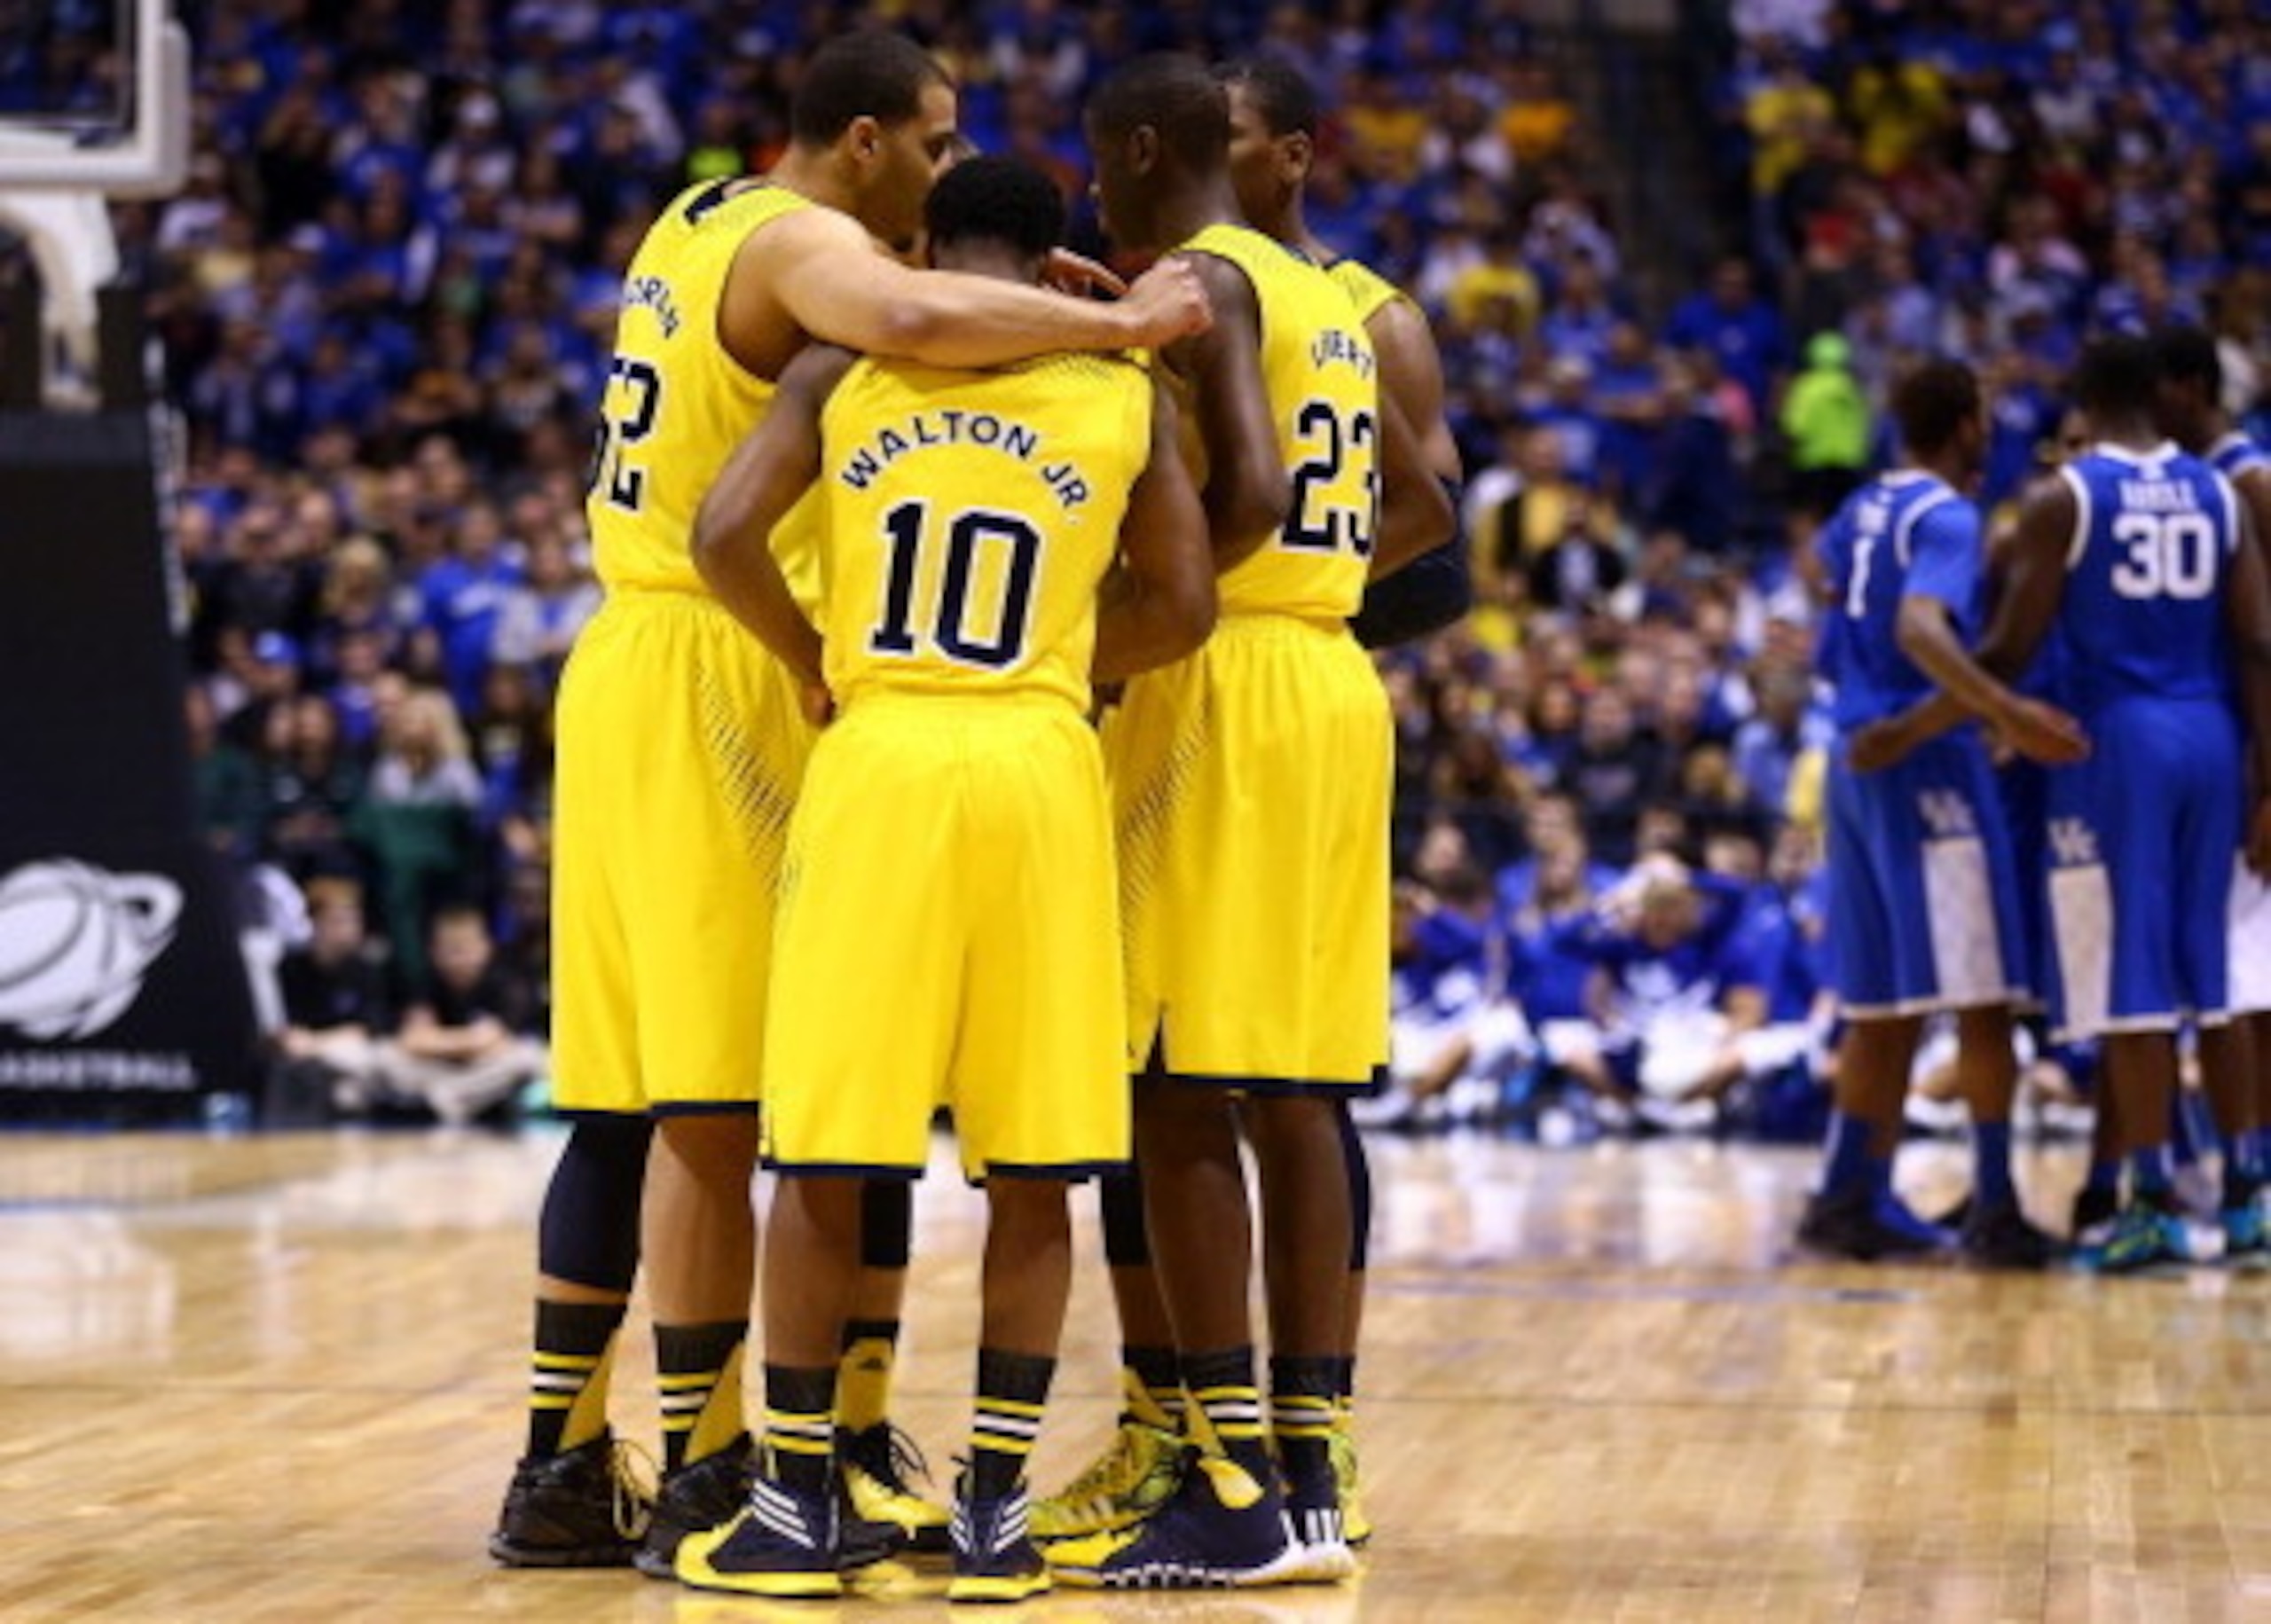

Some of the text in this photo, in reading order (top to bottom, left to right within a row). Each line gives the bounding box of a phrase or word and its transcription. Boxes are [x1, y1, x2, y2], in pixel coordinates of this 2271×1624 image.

[842, 412, 1037, 489] WALTON
[868, 500, 1043, 671] 10
[1848, 535, 1875, 618] 1
[2112, 513, 2215, 600] 30
